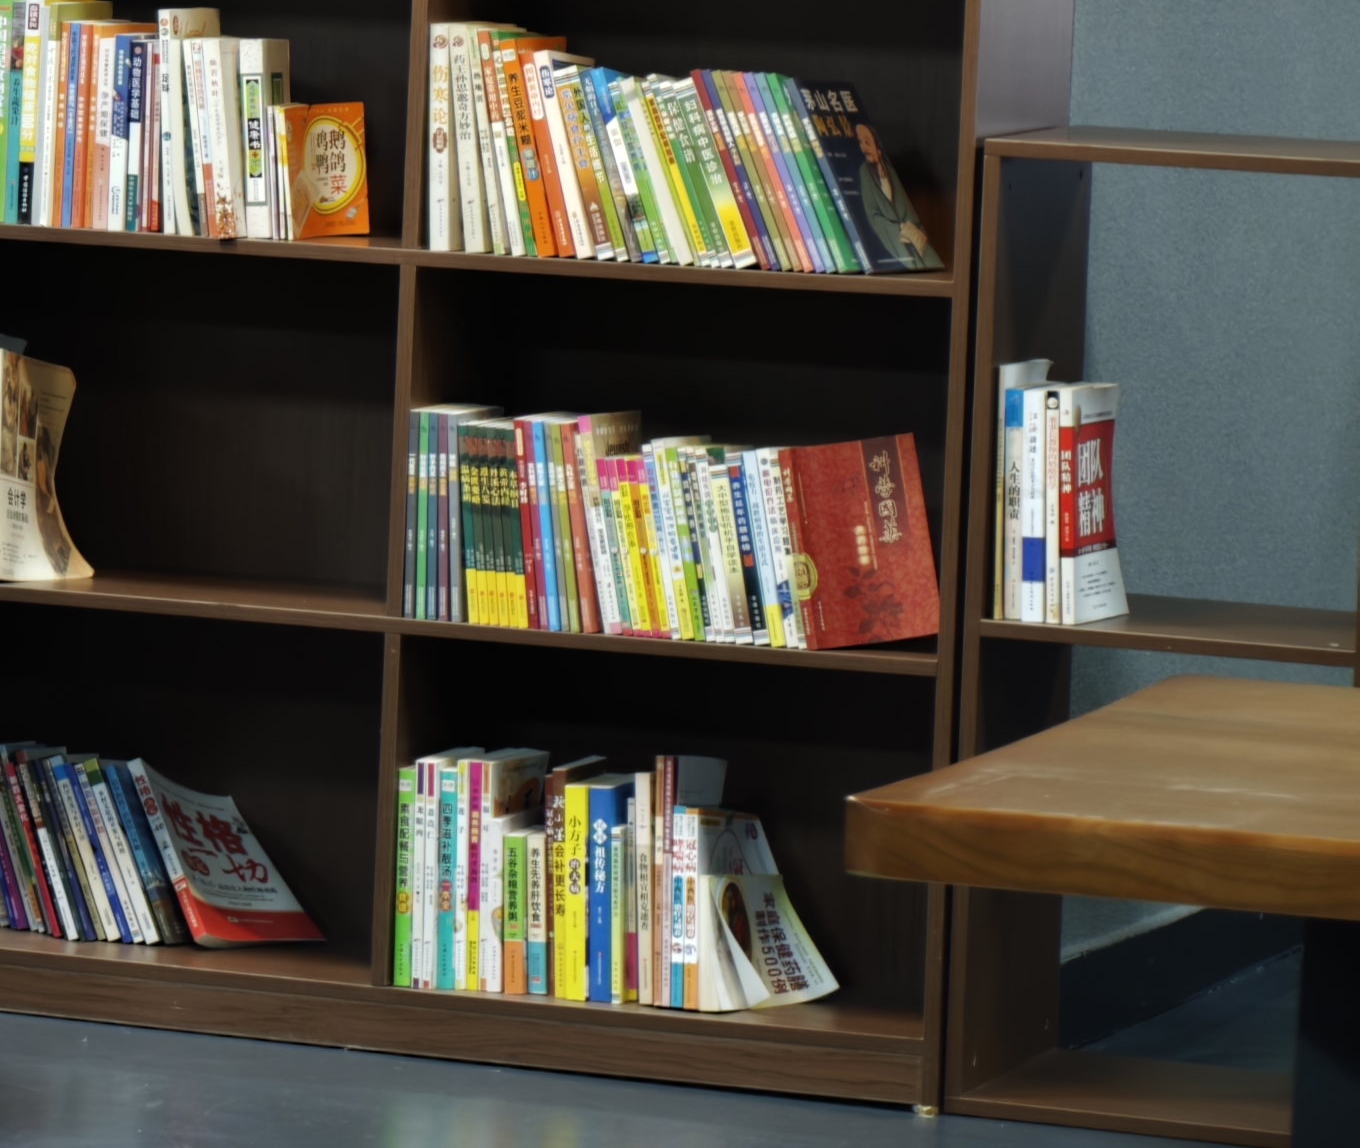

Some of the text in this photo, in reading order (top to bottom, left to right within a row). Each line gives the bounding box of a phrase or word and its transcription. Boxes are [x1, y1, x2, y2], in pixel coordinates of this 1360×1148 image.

[100, 91, 110, 138] 孕产期保健
[130, 56, 142, 120] 动物医学基础
[432, 66, 449, 125] 伤寒论
[453, 54, 471, 141] 药王孙思邈奇方妙治
[508, 73, 532, 145] 养生豆浆米糊
[667, 103, 696, 164] 保健食谱
[684, 100, 723, 185] 妇科病中医诊治
[605, 440, 630, 456] Jewish
[1060, 450, 1072, 494] 团队精神
[1077, 438, 1104, 486] 团队
[7, 487, 27, 508] 会计学
[1008, 462, 1020, 520] 人生的职责
[1078, 487, 1106, 537] 精神
[716, 484, 739, 574] 大中型拖拉机机手自学读本
[160, 792, 248, 856] 性格
[441, 804, 453, 878] 四季滋补靓汤
[507, 848, 518, 922] 五谷杂粮营养粥
[531, 848, 541, 923] 养生先养肝饮食
